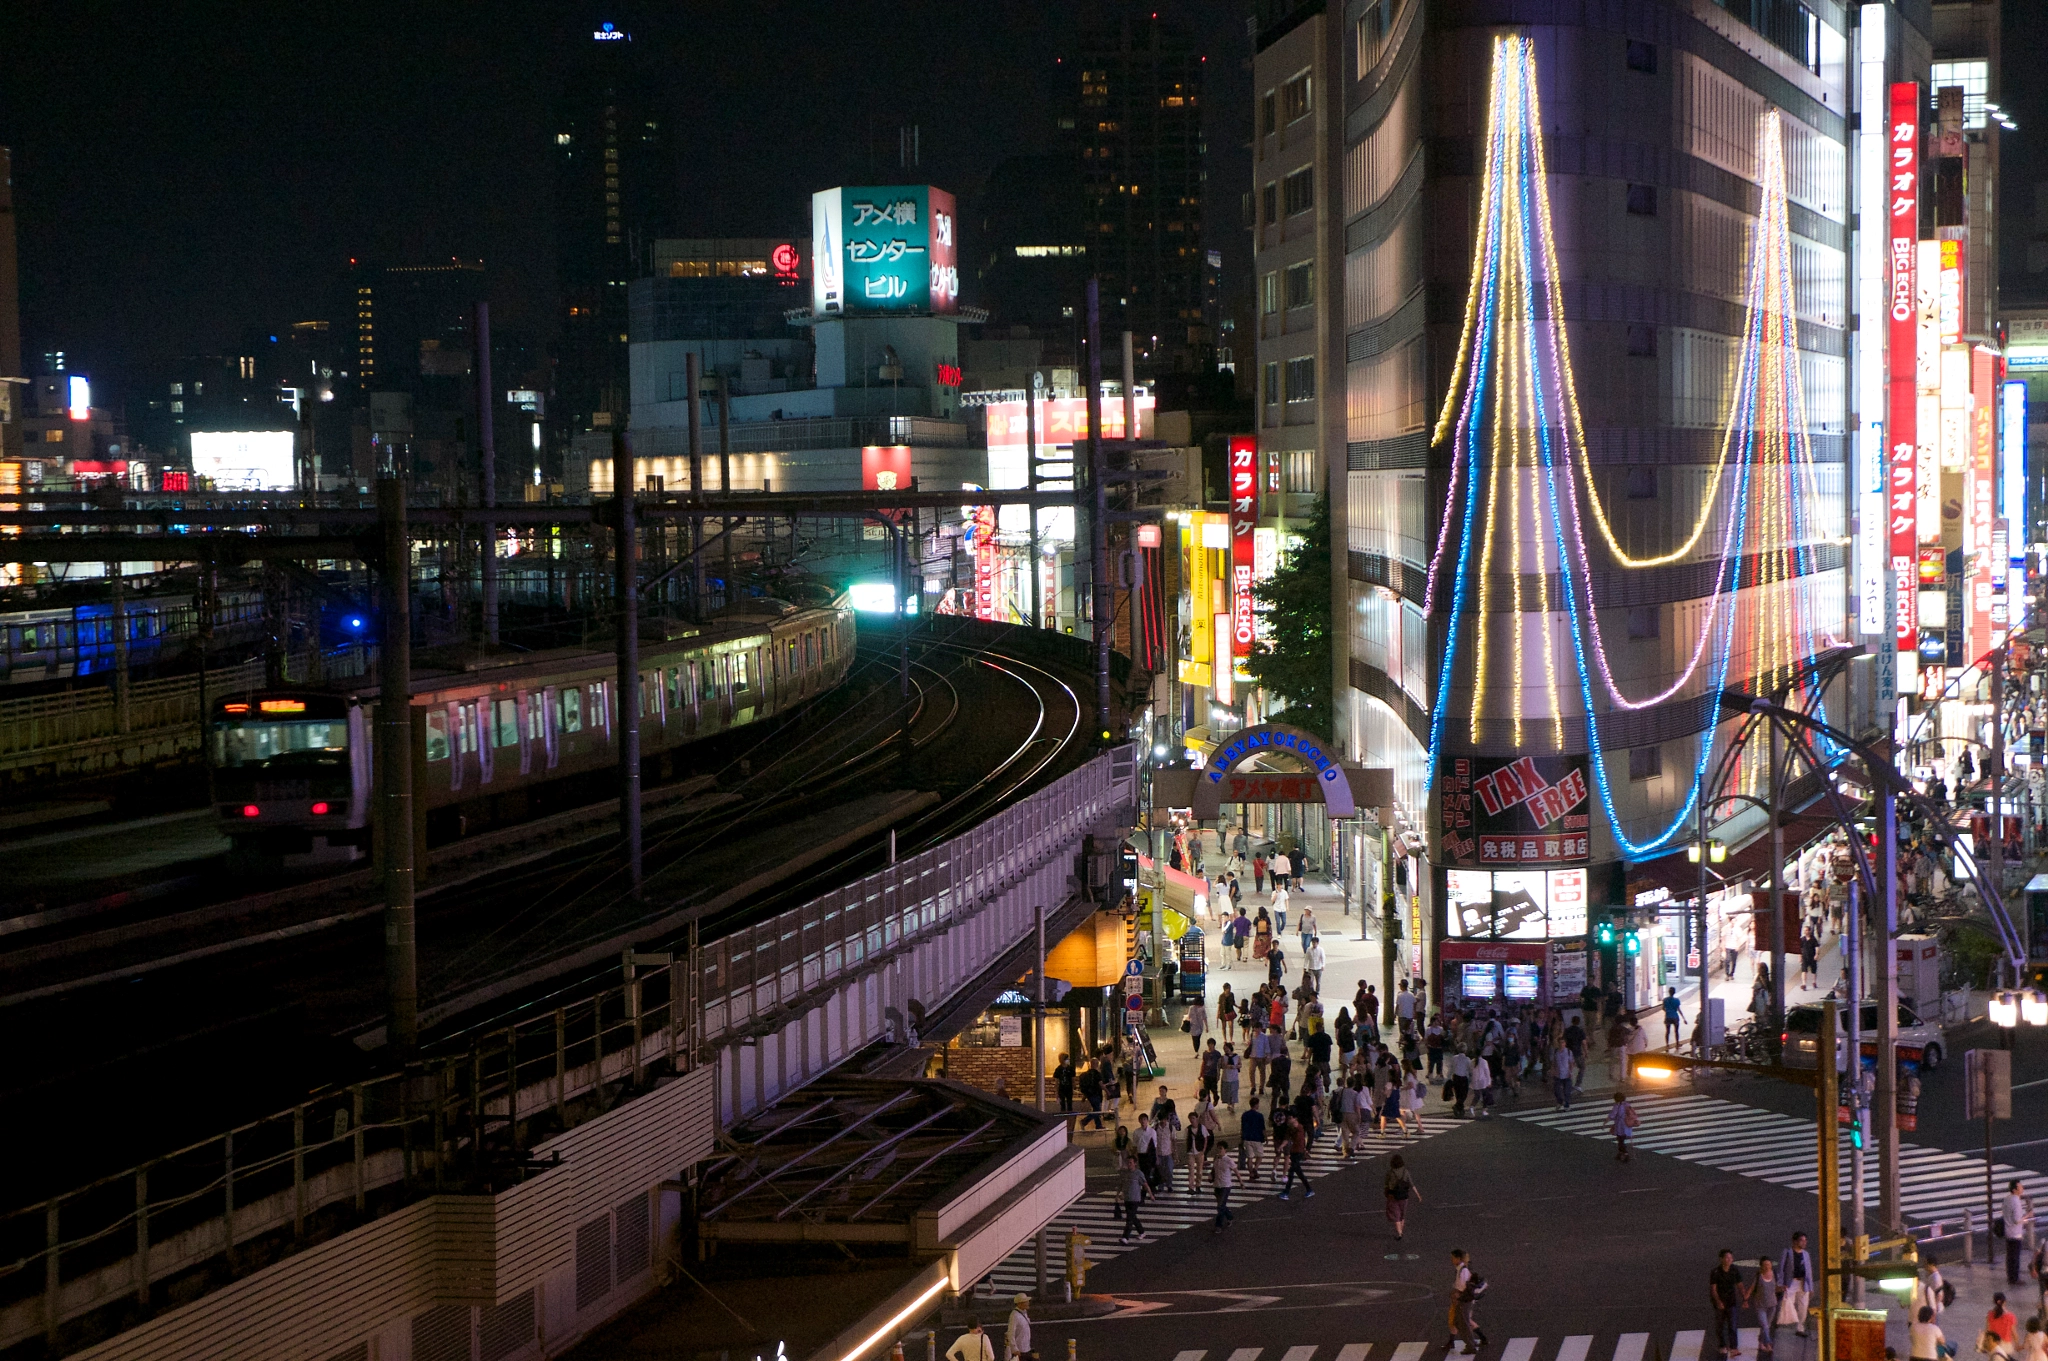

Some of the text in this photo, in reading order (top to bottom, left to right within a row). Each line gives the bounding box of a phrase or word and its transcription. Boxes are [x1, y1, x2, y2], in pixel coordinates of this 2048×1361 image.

[1893, 123, 1914, 216] カラオケ
[852, 201, 917, 226] アメ横
[847, 240, 925, 263] センター
[1893, 237, 1910, 321] BIG ECHO
[866, 275, 907, 298] ビル
[1976, 406, 1990, 469] パチンコ
[1234, 449, 1253, 536] カラオケ
[1892, 442, 1913, 535] カラオケ
[1893, 556, 1910, 588] BIG
[1235, 565, 1251, 643] BIG ECHO
[1209, 732, 1337, 784] AMEYAYOKOCHO
[1230, 777, 1317, 799] アメヤ横丁
[1474, 756, 1549, 816] TAX
[1442, 775, 1454, 828] カメラ
[1455, 759, 1470, 828] ヨドバシ
[1525, 768, 1588, 830] FREE
[1483, 838, 1587, 859] 免税品取扱店
